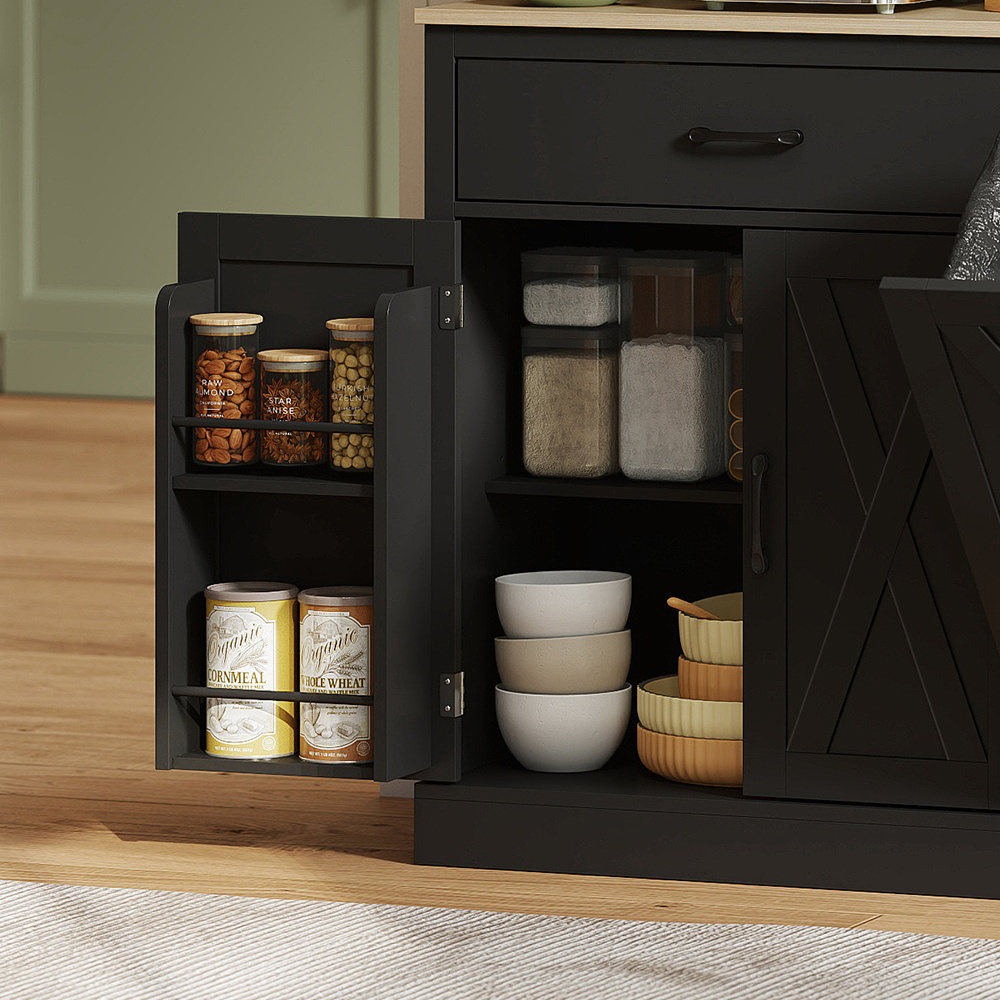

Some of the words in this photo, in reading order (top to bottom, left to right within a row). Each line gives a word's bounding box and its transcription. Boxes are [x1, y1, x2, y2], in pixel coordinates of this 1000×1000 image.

[201, 379, 223, 387] RAW
[268, 397, 292, 405] STAR
[266, 407, 295, 415] ANISE
[207, 623, 262, 667] Organic
[302, 627, 359, 673] Organic
[207, 668, 267, 684] CORNMEAL
[327, 677, 366, 689] WHEAT
